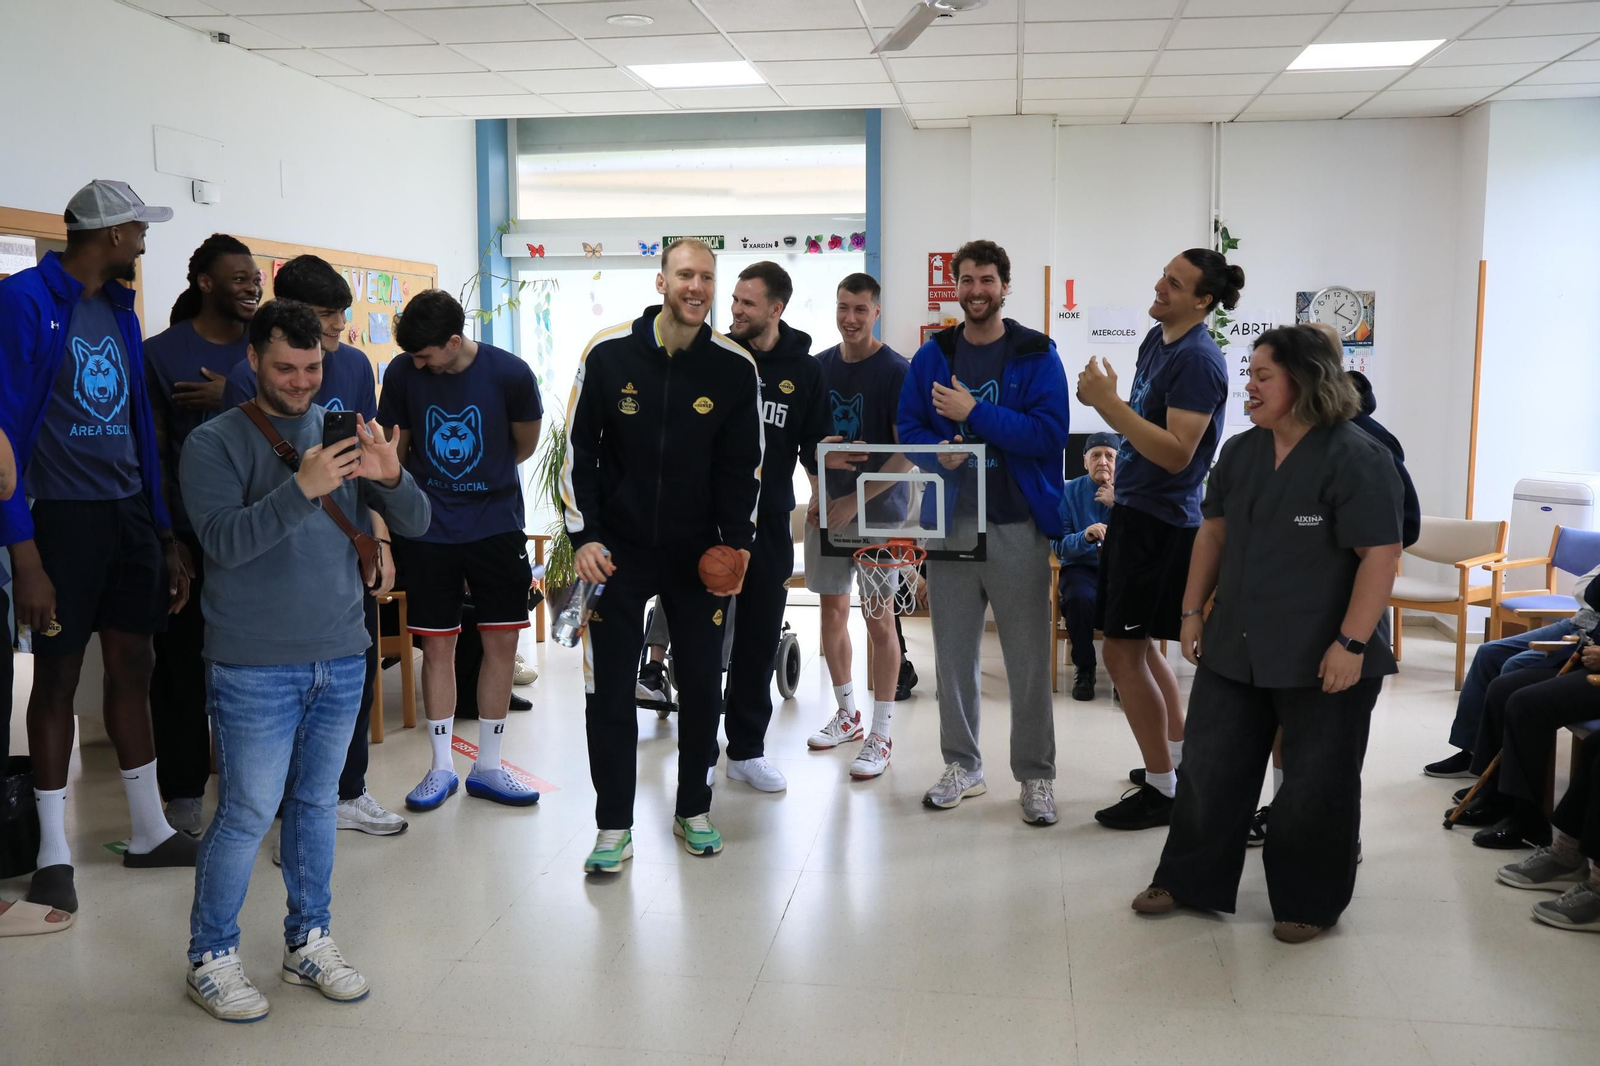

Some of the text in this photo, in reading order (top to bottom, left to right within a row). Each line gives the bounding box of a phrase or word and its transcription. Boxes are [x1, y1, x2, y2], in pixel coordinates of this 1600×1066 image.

[70, 424, 129, 436] ÁREA SOCI
[452, 482, 488, 492] SOCIAL
[1294, 514, 1324, 522] AIXIÑA
